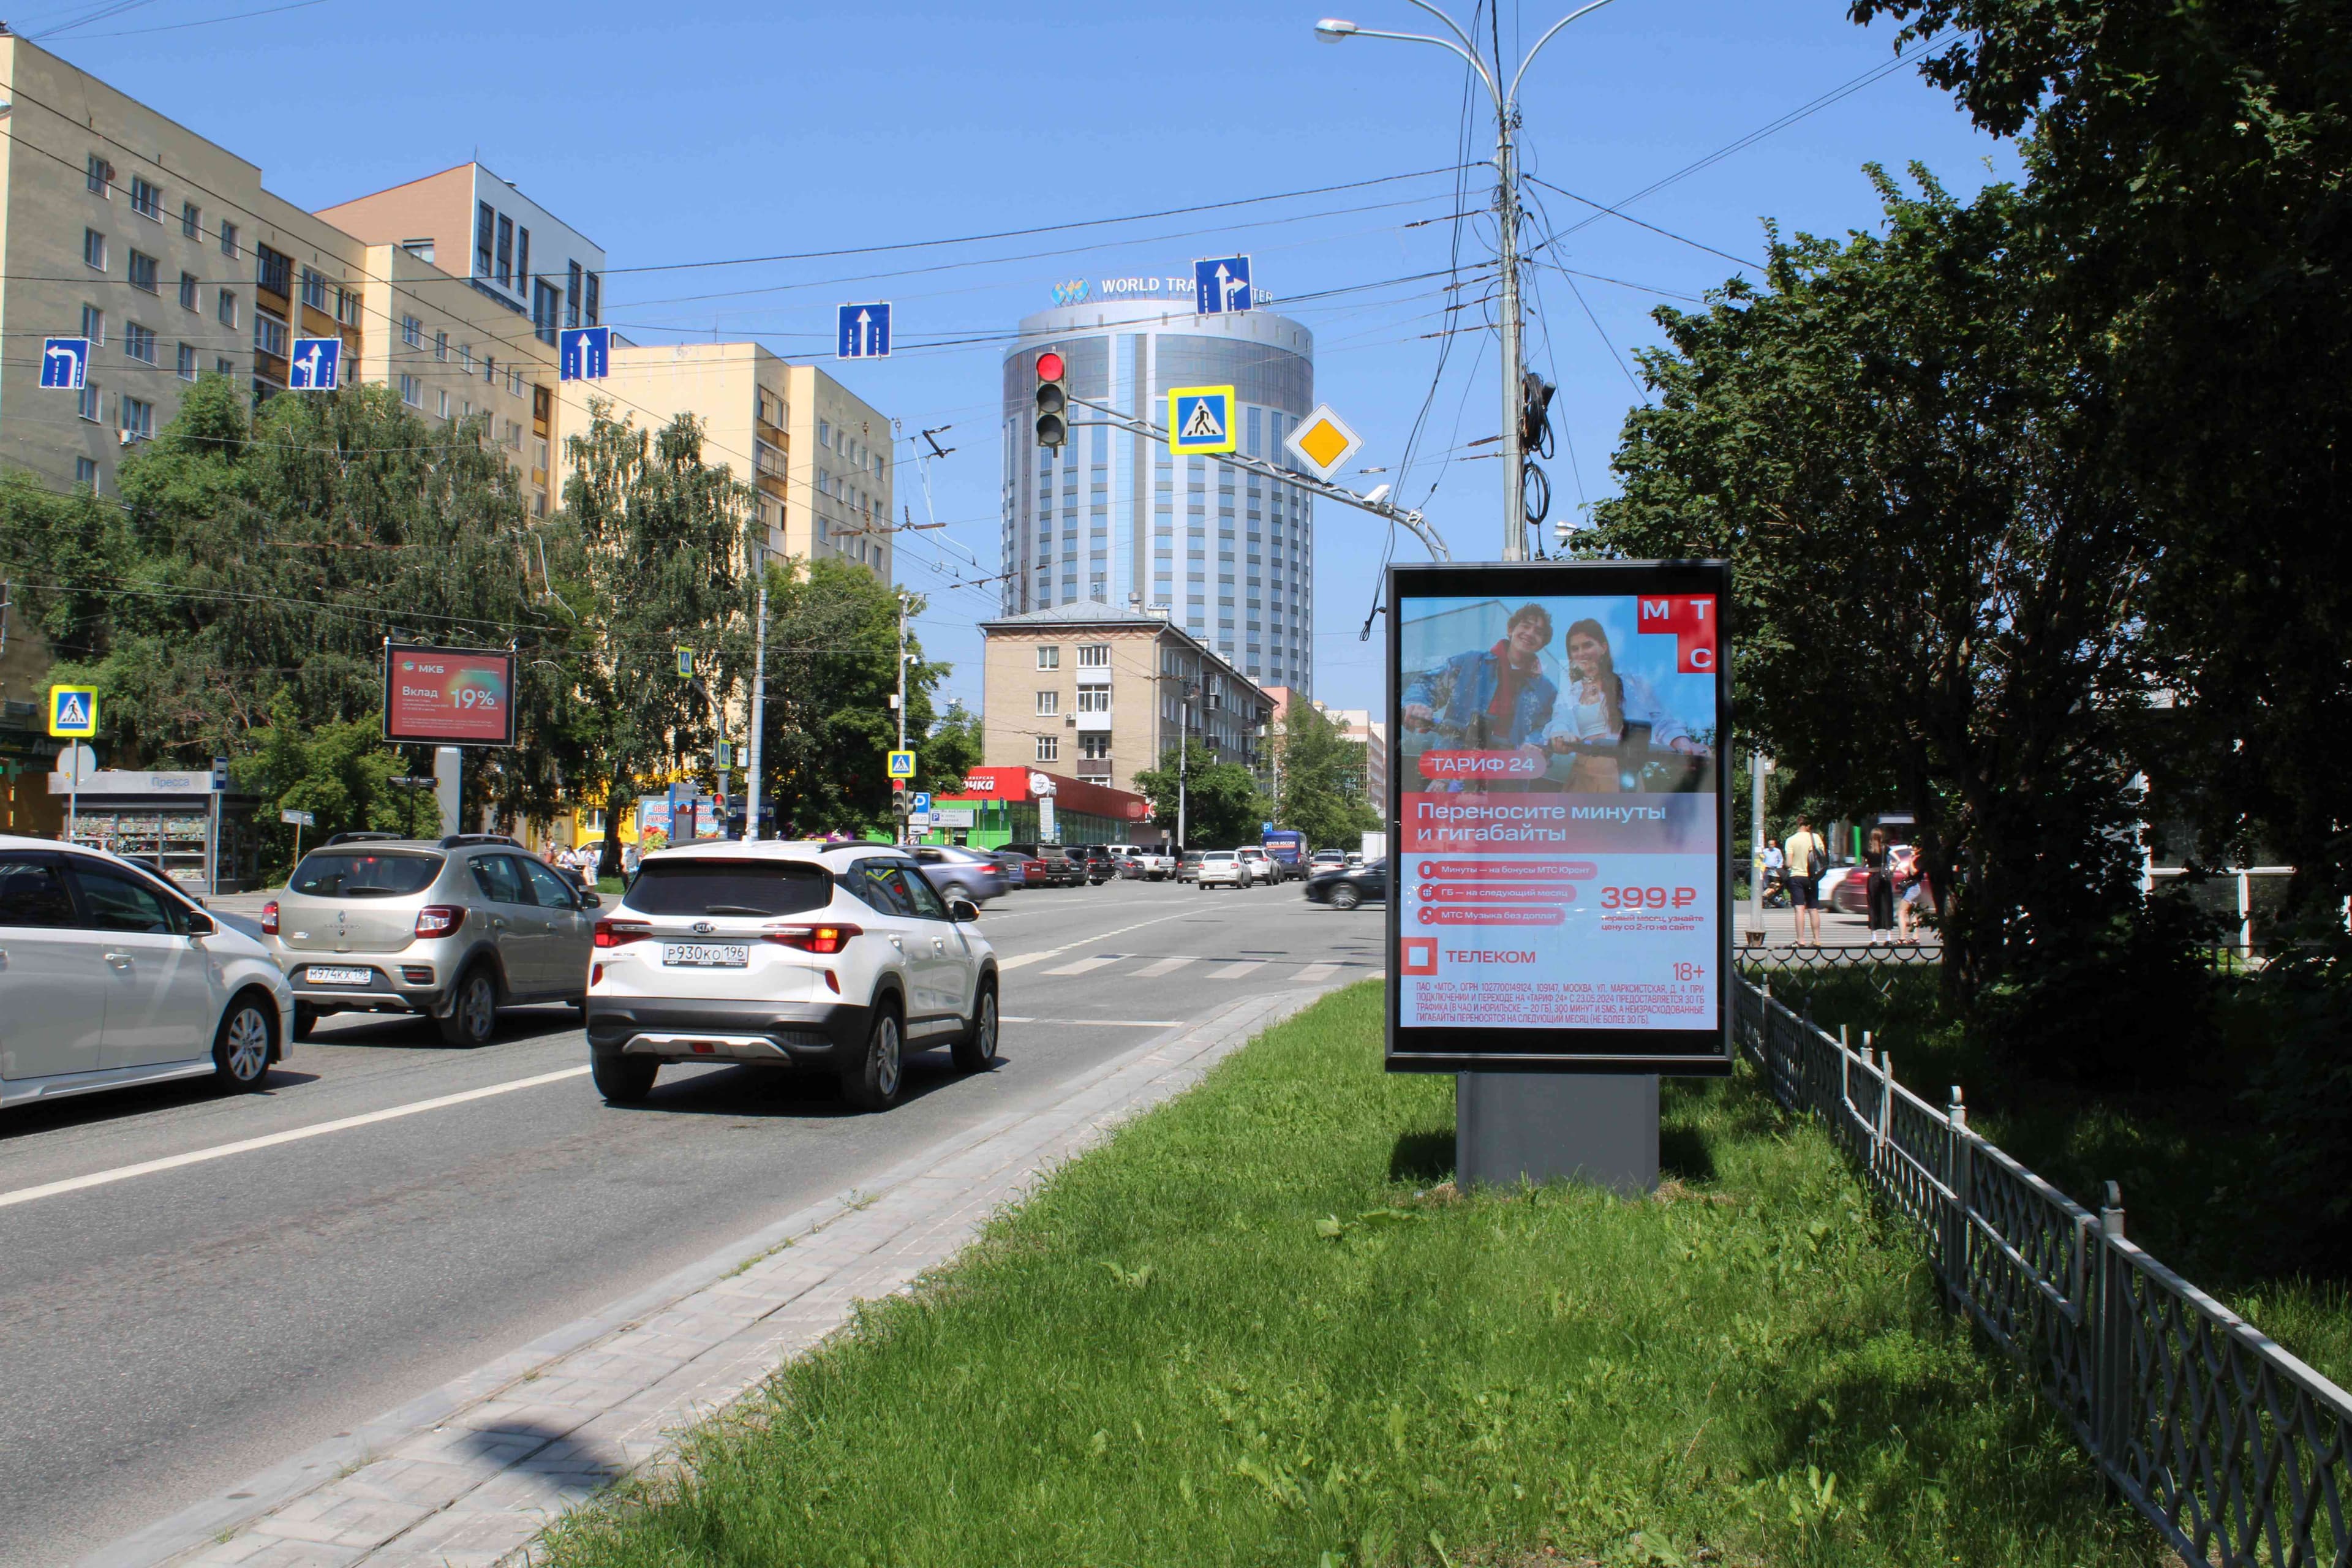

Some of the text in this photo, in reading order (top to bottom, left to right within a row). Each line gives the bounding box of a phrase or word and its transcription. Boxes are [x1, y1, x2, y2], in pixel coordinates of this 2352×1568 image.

[1102, 277, 1273, 304] WORLD TRA TER
[418, 665, 444, 674] МКБ
[402, 686, 495, 709] Вклад 19%
[1431, 758, 1535, 773] ТАРИФ 24
[152, 777, 190, 789] Пресса
[963, 780, 995, 791] очка
[1418, 802, 1666, 824] Переносите минуты
[1418, 823, 1566, 842] и гигабайты
[1479, 889, 1536, 898] следующий
[1600, 887, 1697, 909] 399 ₽
[695, 924, 712, 932] KIA
[724, 947, 744, 957] 196
[1446, 951, 1536, 963] ТЕЛЕКОМ
[1673, 962, 1705, 981] 18+
[1416, 982, 1430, 991] ПАО
[1460, 982, 1478, 991] ОГРН
[1690, 985, 1704, 993] ПРИ
[1416, 993, 1469, 1003] ПОДКЛЮЧЕНИИ
[1478, 993, 1513, 1003] ПЕРЕХОДЕ
[1570, 994, 1574, 1003] С
[1616, 995, 1683, 1005] ПРЕДОСТАВЛЯЕТСЯ
[1686, 995, 1694, 1004] 30
[1696, 995, 1704, 1004] ГБ
[1416, 1003, 1447, 1011] ТРАФИКА
[1458, 1003, 1471, 1012] ЧАО
[1480, 1003, 1521, 1012] НОРИЛЬСКЕ
[1531, 1004, 1539, 1012] 20
[1556, 1004, 1569, 1014] 300
[1625, 1005, 1704, 1015] НЕИЗРАСХОДОВАННЫЕ
[1416, 1012, 1455, 1022] ГИГАБАЙТЫ
[1457, 1014, 1506, 1022] ПЕРЕНОСЯТСЯ
[1518, 1013, 1563, 1024] СЛЕДУЮЩИЙ
[1565, 1014, 1588, 1023] МЕСЯЦ
[1591, 1014, 1601, 1025] (НЕ
[1604, 1015, 1625, 1023] БОЛЕЕ
[1627, 1015, 1636, 1023] 30
